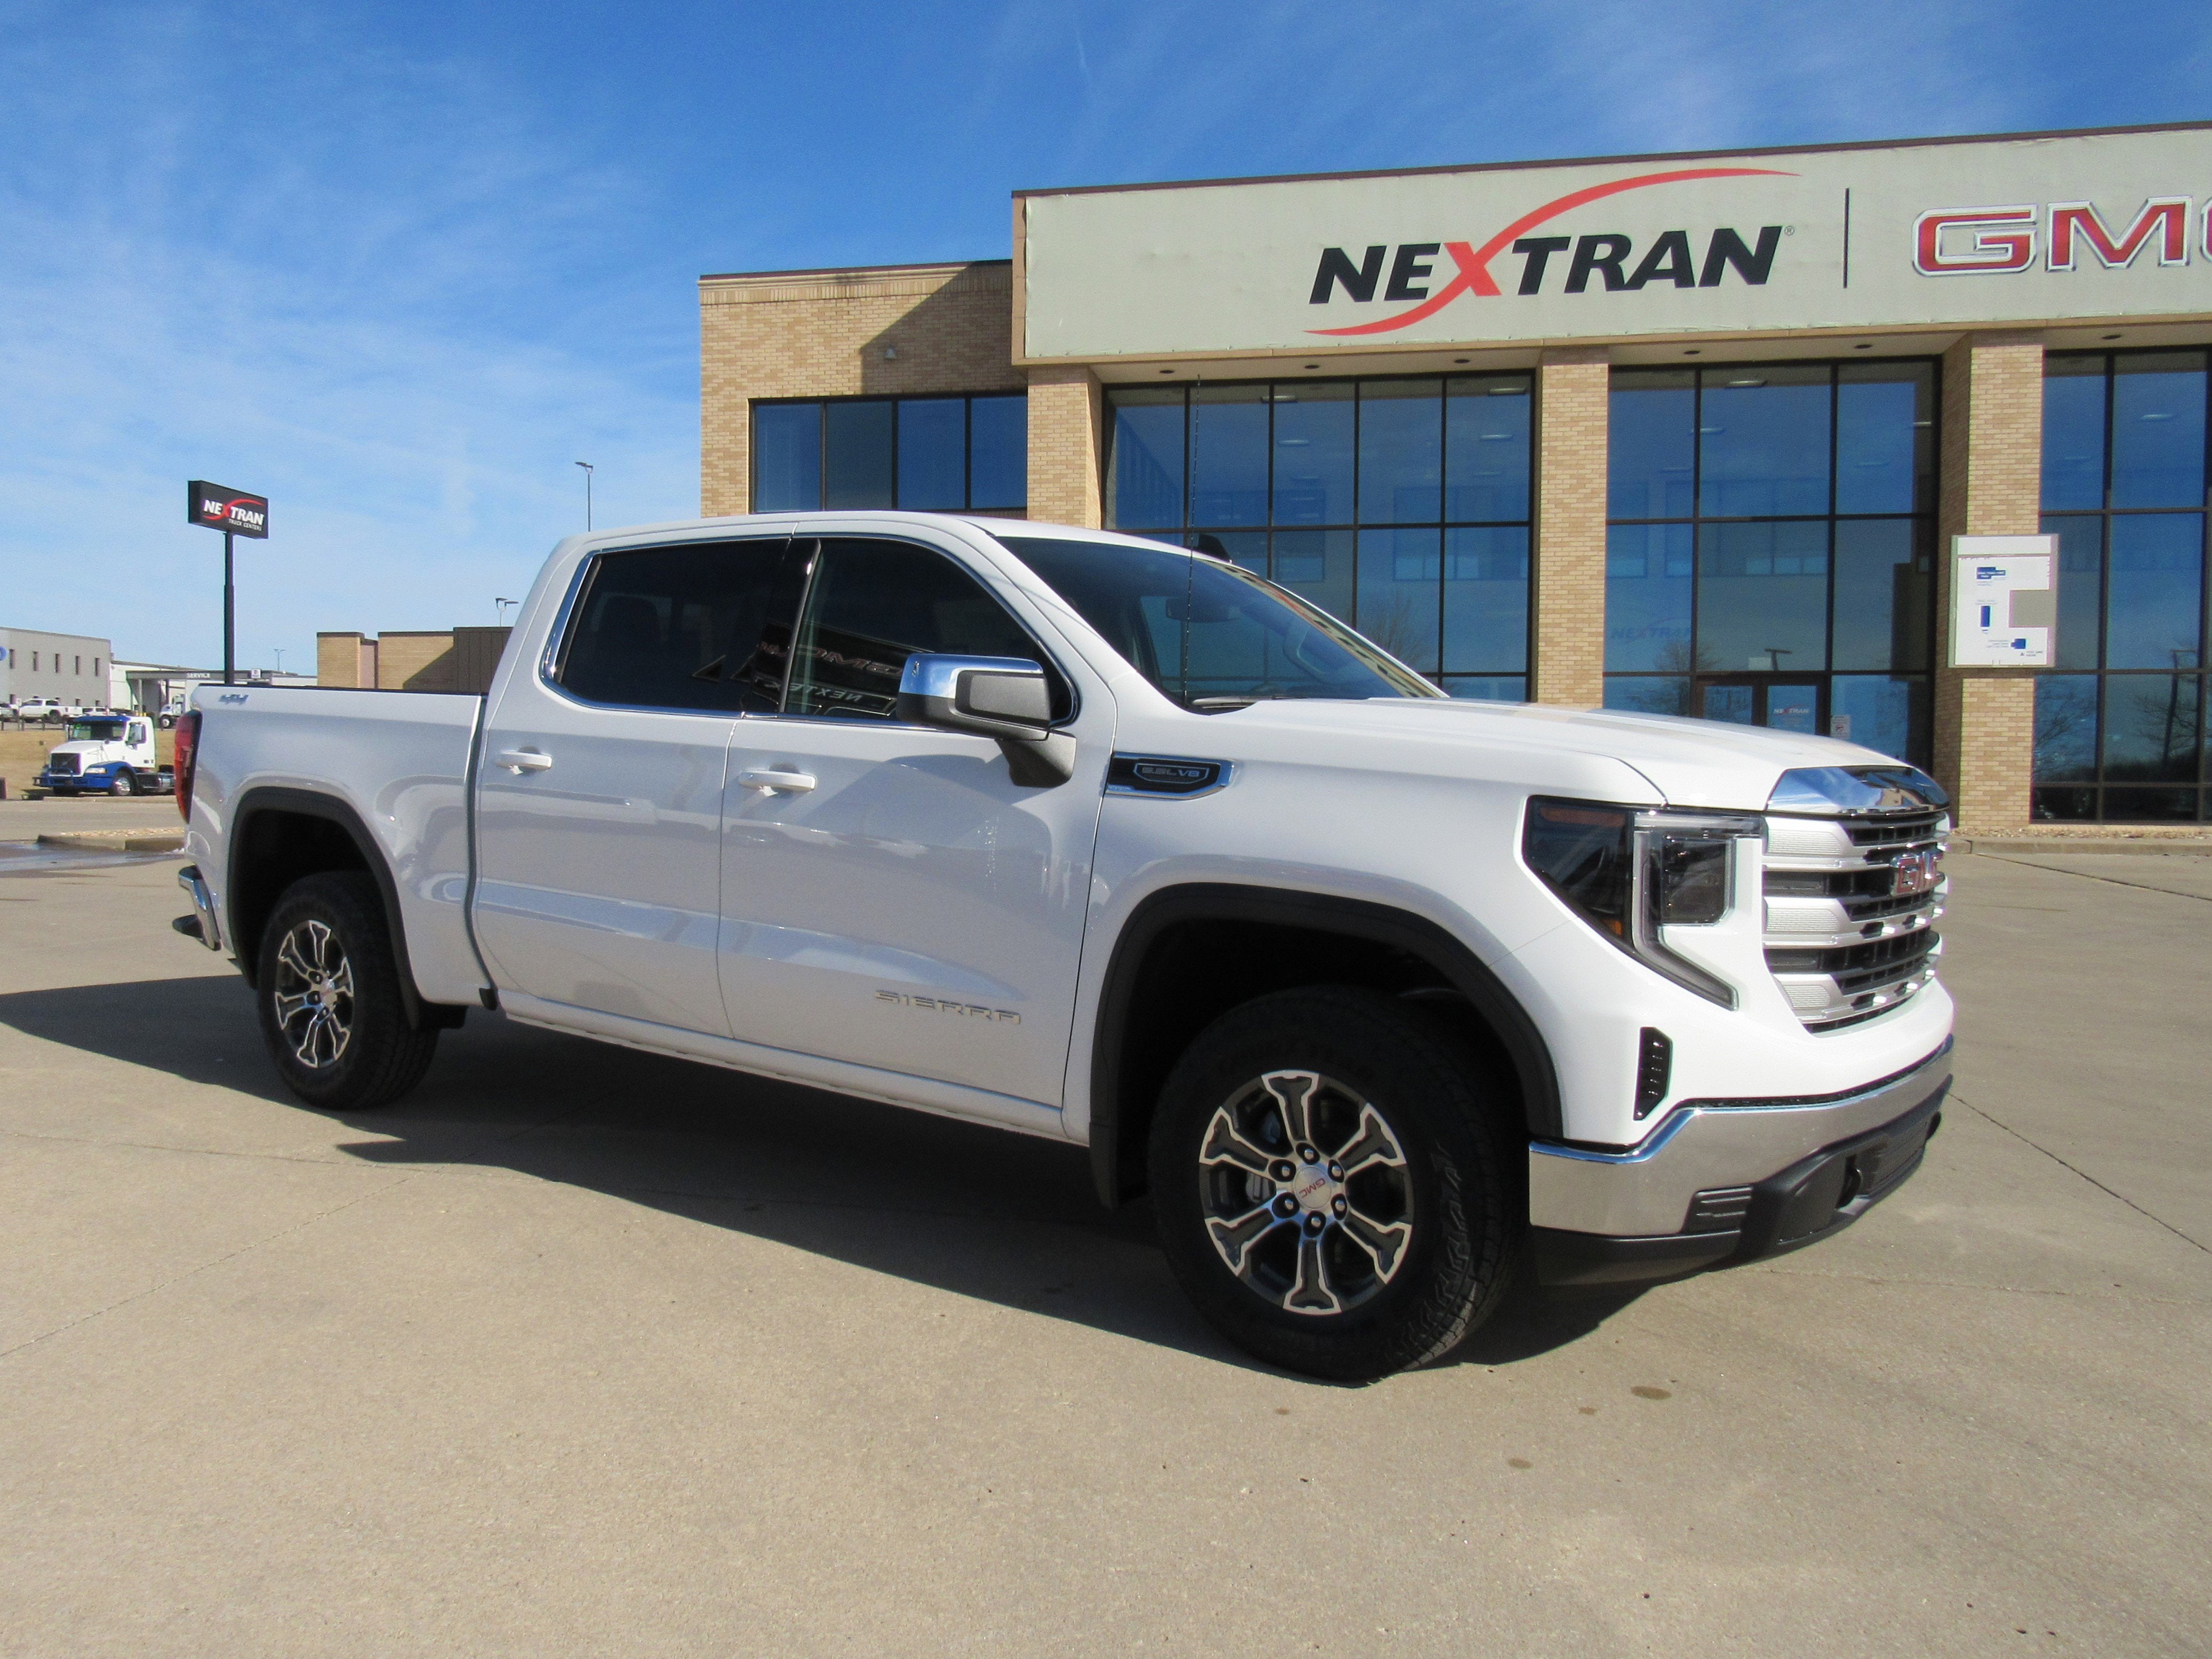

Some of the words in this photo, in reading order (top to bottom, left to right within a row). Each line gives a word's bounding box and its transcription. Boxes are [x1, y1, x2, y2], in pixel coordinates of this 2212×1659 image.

[1912, 195, 2212, 277] GM
[203, 499, 265, 525] NEXTRAN
[875, 990, 1021, 1024] SIERRA
[1299, 1177, 1326, 1198] GMC
